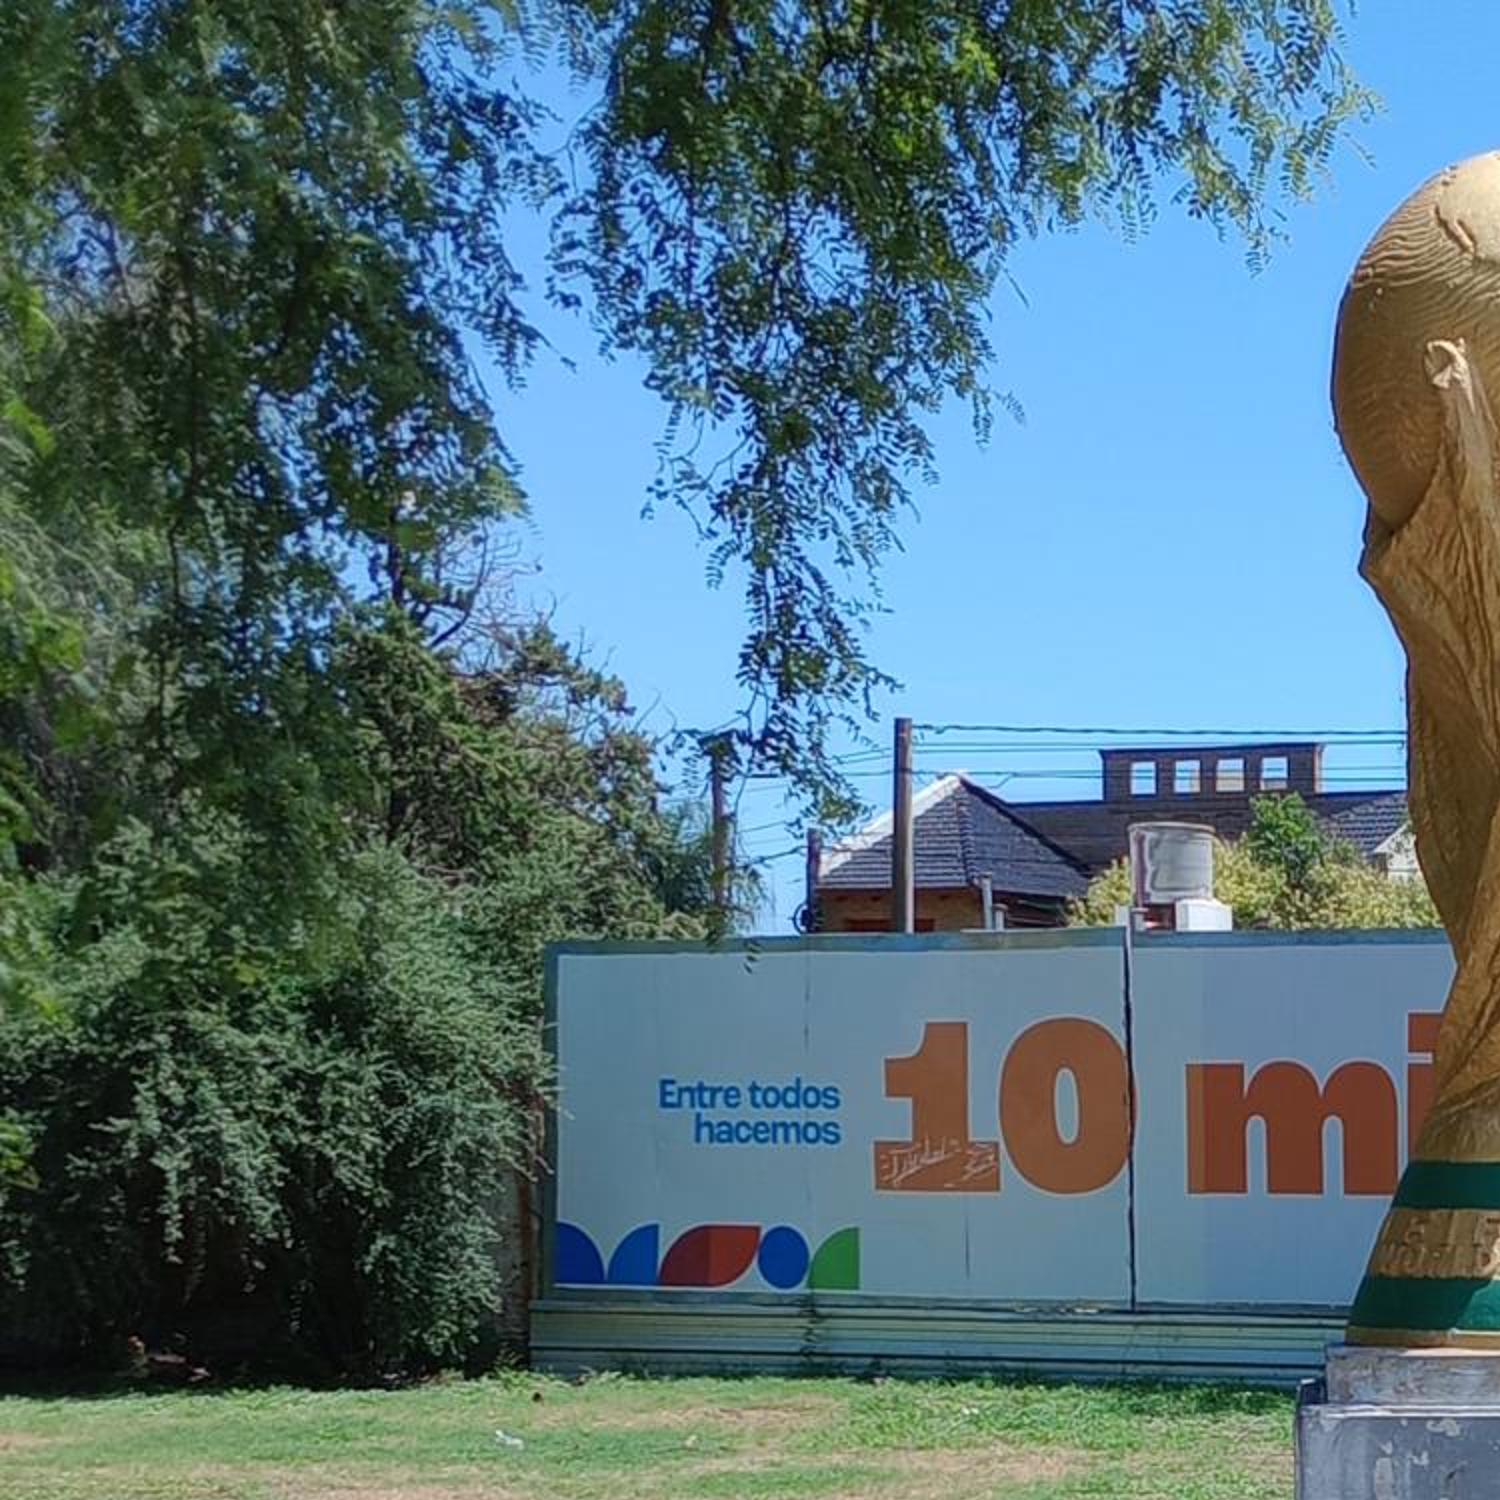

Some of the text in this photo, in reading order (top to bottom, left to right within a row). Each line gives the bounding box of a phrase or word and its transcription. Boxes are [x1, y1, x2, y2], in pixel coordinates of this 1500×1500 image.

[659, 1076, 841, 1109] Entre todos
[874, 1017, 1136, 1194] 10
[694, 1112, 841, 1145] hacemos
